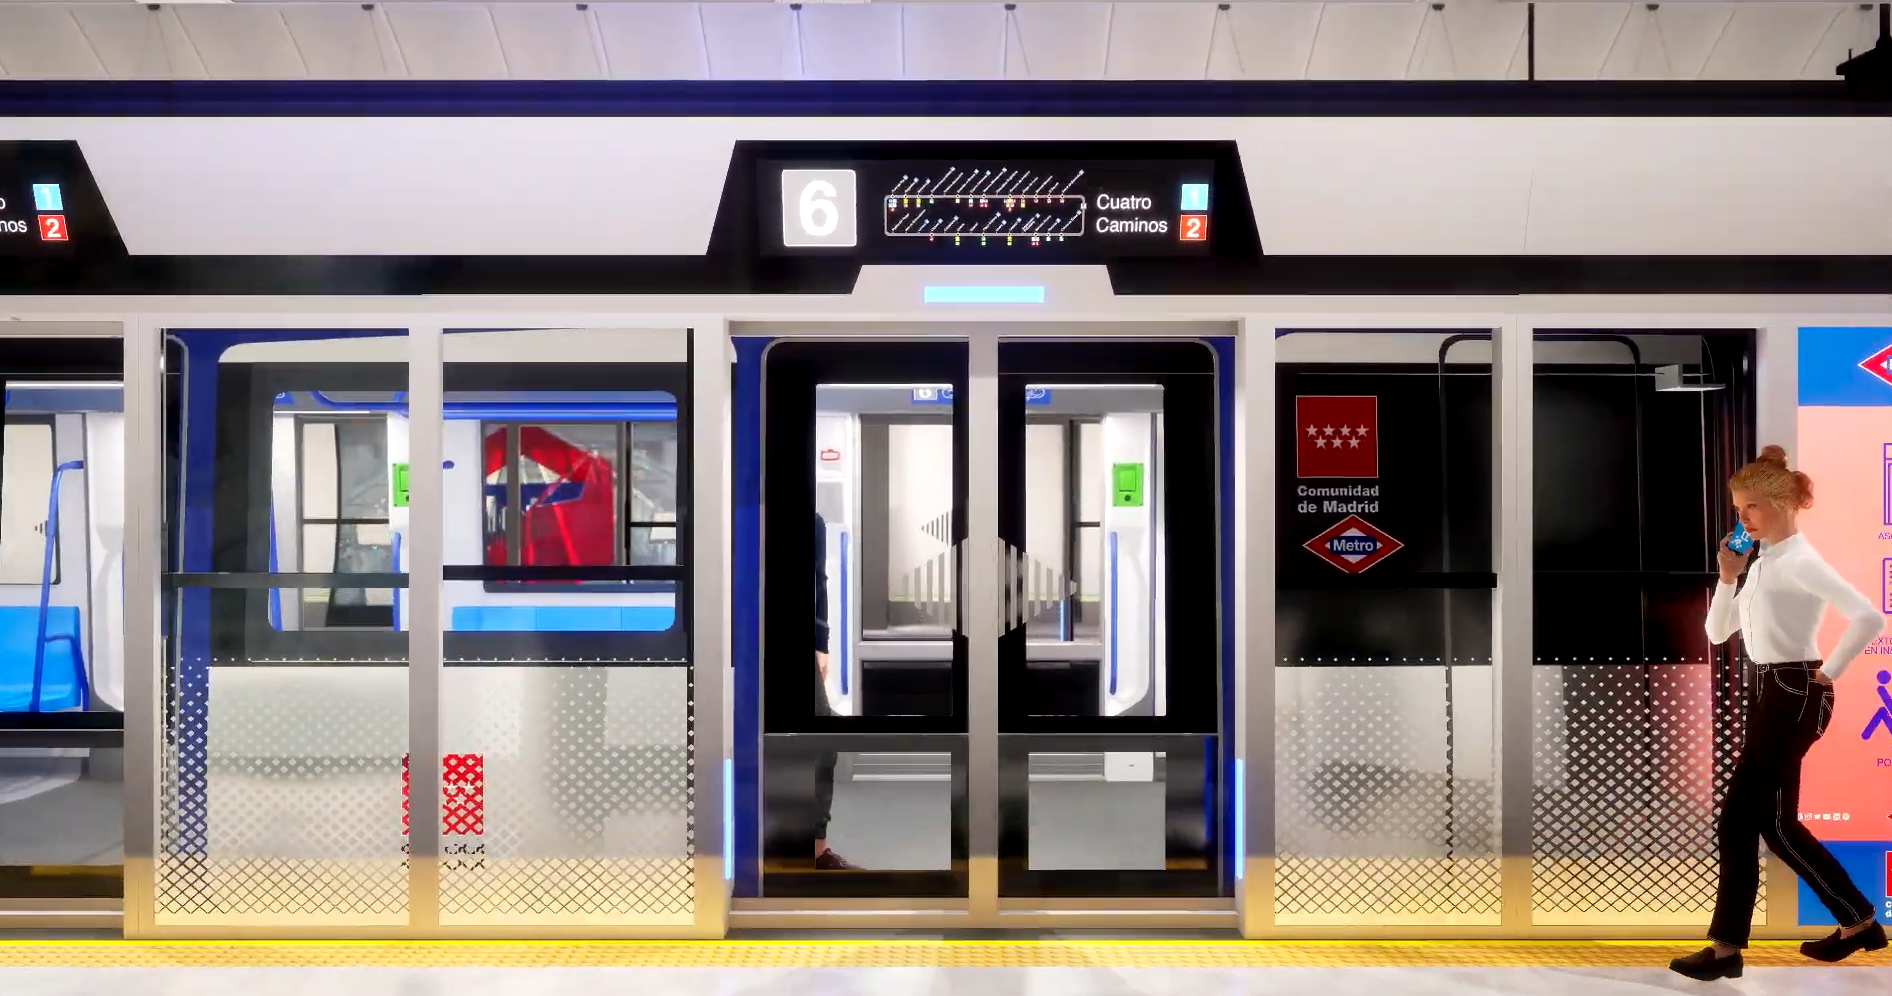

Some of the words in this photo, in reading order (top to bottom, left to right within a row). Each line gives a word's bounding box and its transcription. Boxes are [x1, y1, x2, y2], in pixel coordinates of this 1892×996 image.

[41, 187, 51, 208] 1
[1096, 193, 1152, 210] Cuatro
[1189, 188, 1199, 207] 1
[800, 180, 839, 237] 6
[45, 218, 61, 238] 2
[1096, 216, 1168, 233] Caminos
[1187, 218, 1200, 237] 2
[1297, 485, 1379, 497] Comunidad
[1297, 500, 1318, 513] de
[1323, 500, 1379, 513] Madrid
[1333, 539, 1374, 551] Metro
